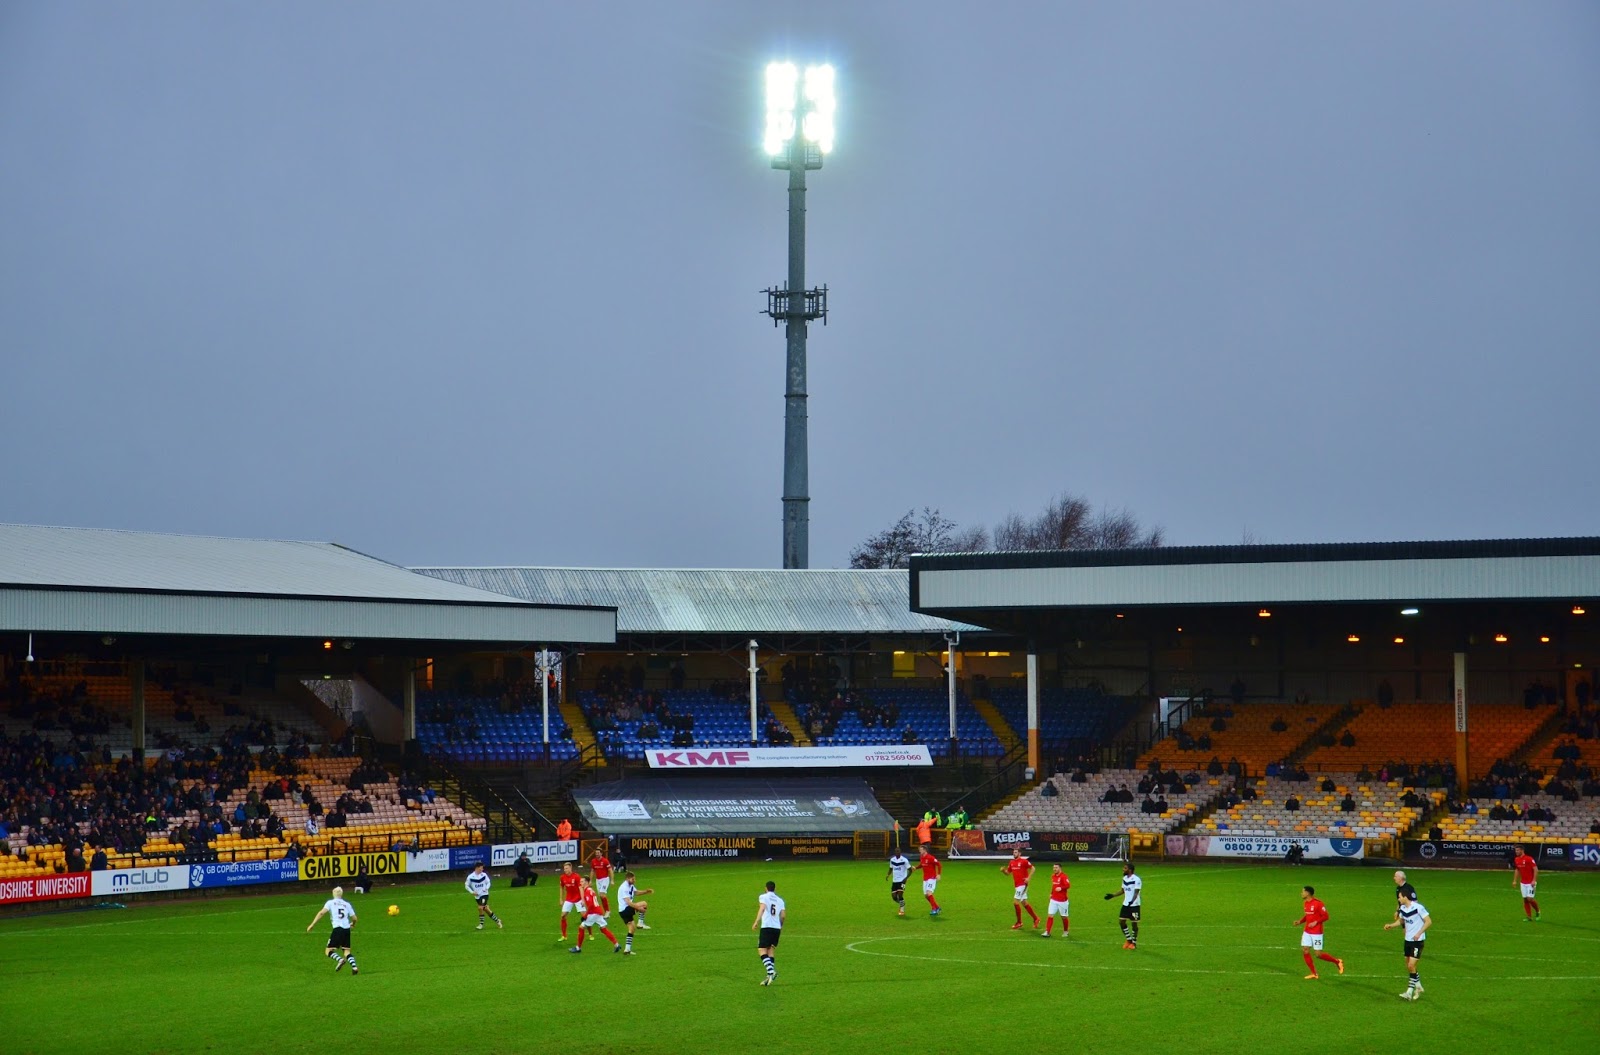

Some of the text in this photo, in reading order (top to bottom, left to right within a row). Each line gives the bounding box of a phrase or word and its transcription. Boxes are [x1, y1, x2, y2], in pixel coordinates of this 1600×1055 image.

[656, 751, 750, 766] KMF
[865, 754, 890, 762] 01782
[631, 837, 756, 850] PORT VALE BUSINESS ALLIANCE
[1040, 833, 1099, 843] FAST FREE DELIVERY
[493, 845, 535, 860] mclub
[537, 840, 576, 857] mclub
[792, 846, 829, 855] @OfficialPVBA
[1061, 842, 1074, 851] 827
[1075, 842, 1089, 851] 659
[1225, 843, 1252, 851] 0800
[1257, 843, 1278, 852] 772
[1546, 847, 1564, 855] A2B
[648, 848, 739, 858] PORTVALECOMMERCIAL.COM
[206, 861, 297, 874] GB COPIER SYSTEMS LTD 01782
[304, 853, 400, 879] GMB UNION
[112, 868, 169, 886] mclub
[280, 870, 298, 879] 814444
[36, 876, 88, 897] UNIVERSITY
[338, 908, 345, 919] 5
[770, 903, 776, 916] 6
